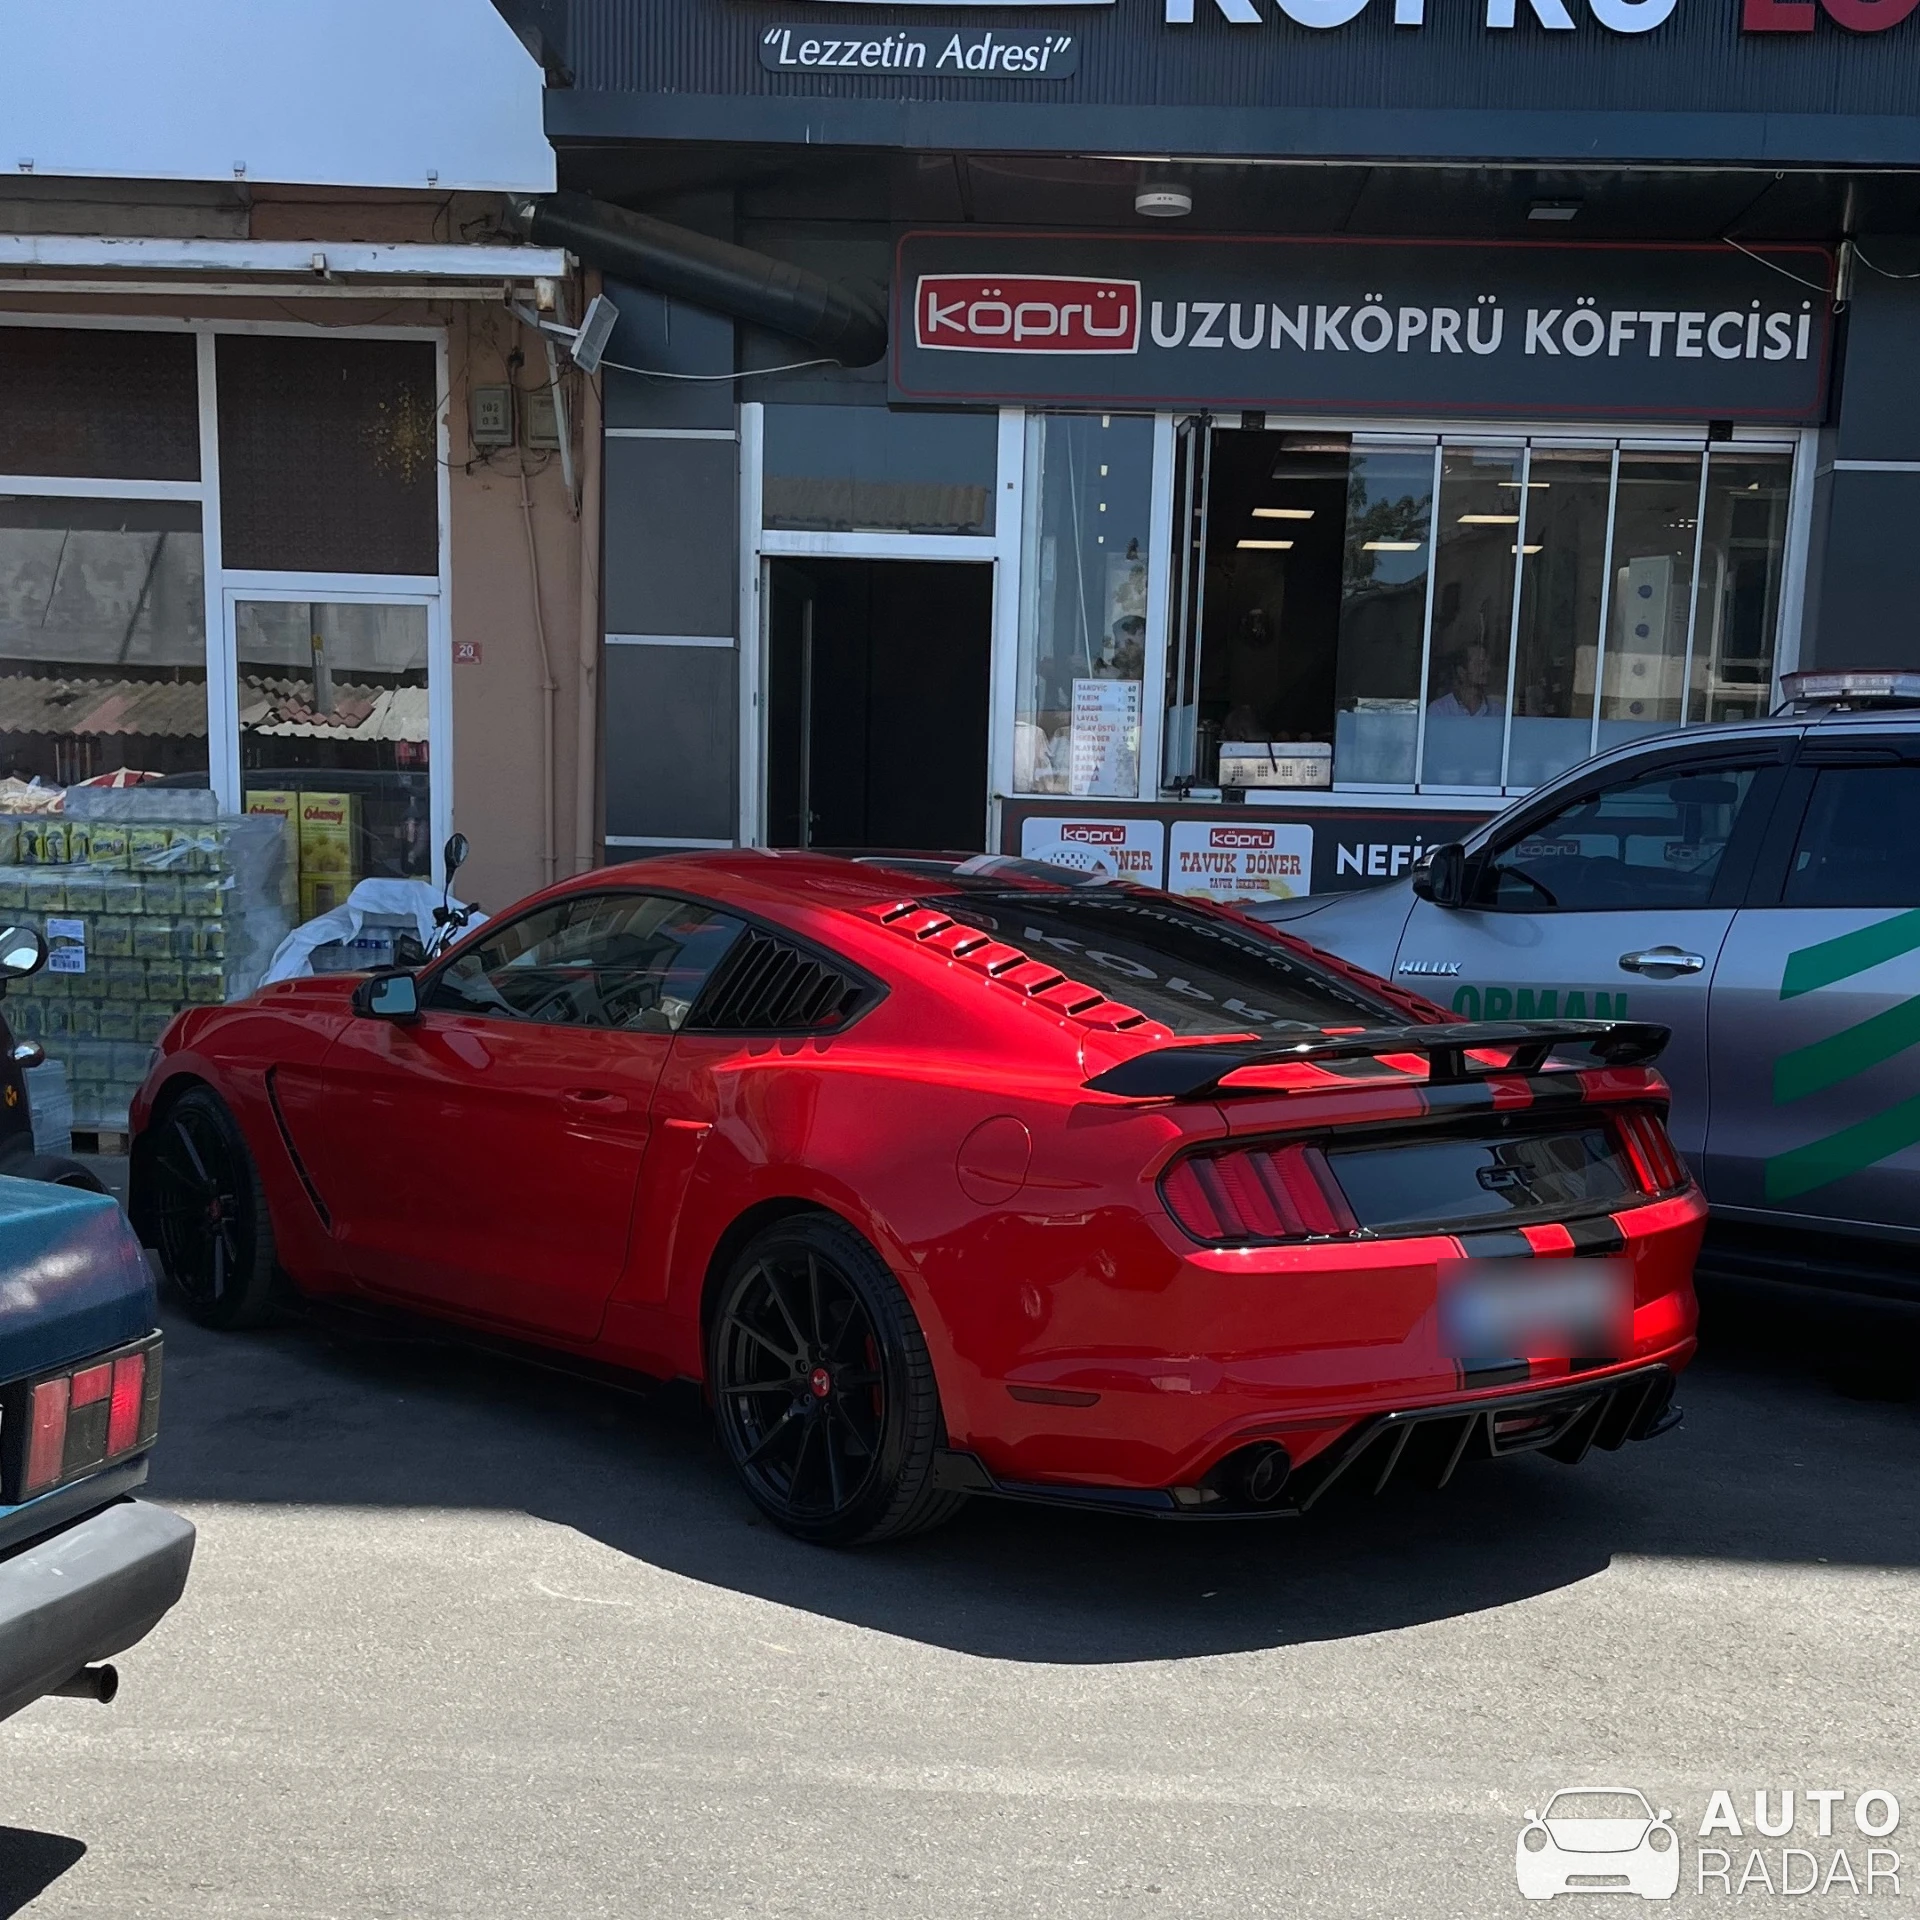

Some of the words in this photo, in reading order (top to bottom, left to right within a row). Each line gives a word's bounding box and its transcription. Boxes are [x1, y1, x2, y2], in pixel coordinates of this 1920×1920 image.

[928, 288, 1129, 342] köprü
[1150, 292, 1504, 355] UZUNKÖPRÜ
[1524, 295, 1811, 361] KÖFTECİSİ
[459, 644, 474, 657] 20
[1063, 826, 1125, 843] köprü
[1211, 830, 1273, 847] köprü
[1109, 846, 1153, 870] ÖNER
[1180, 852, 1237, 873] TAVUK
[1245, 850, 1302, 875] DÖNER
[1336, 835, 1441, 876] NEFİ
[1399, 960, 1463, 976] HILUX
